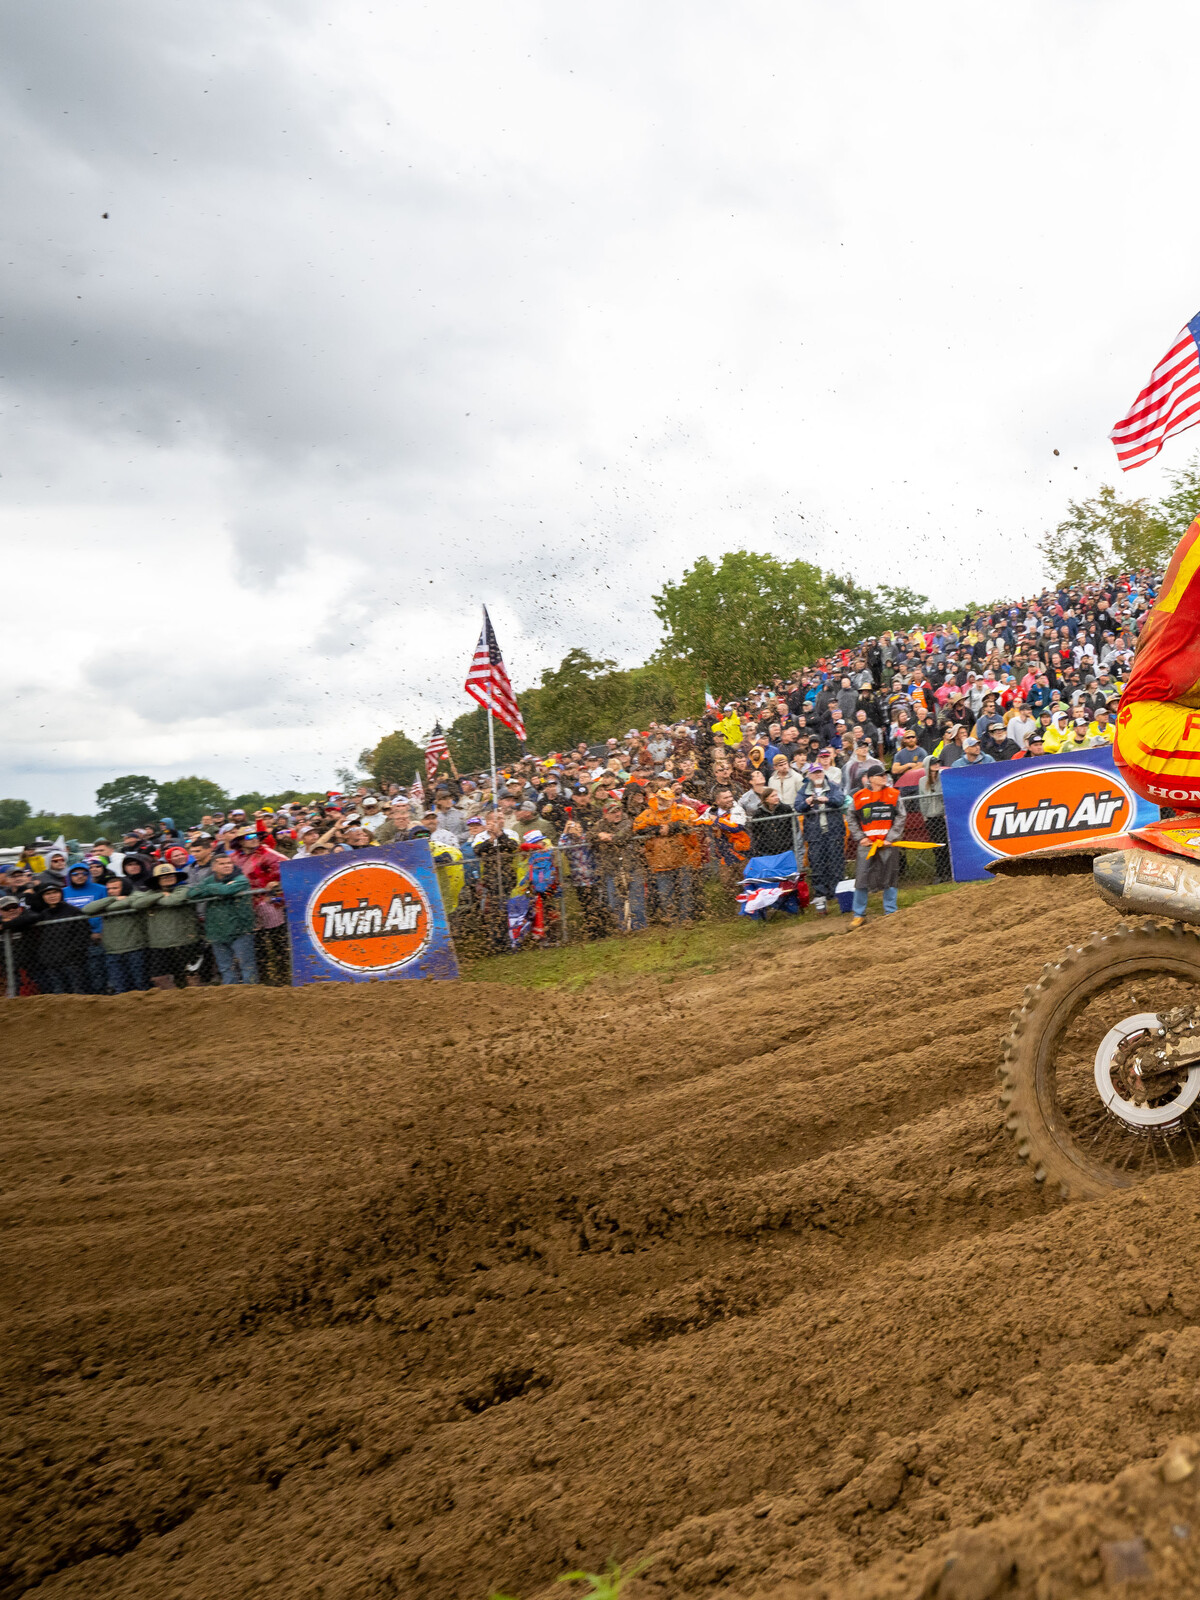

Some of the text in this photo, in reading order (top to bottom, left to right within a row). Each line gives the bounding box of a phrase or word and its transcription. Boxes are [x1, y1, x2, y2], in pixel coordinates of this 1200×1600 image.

[987, 791, 1123, 840] Twin Air
[320, 893, 422, 940] Twin Air
